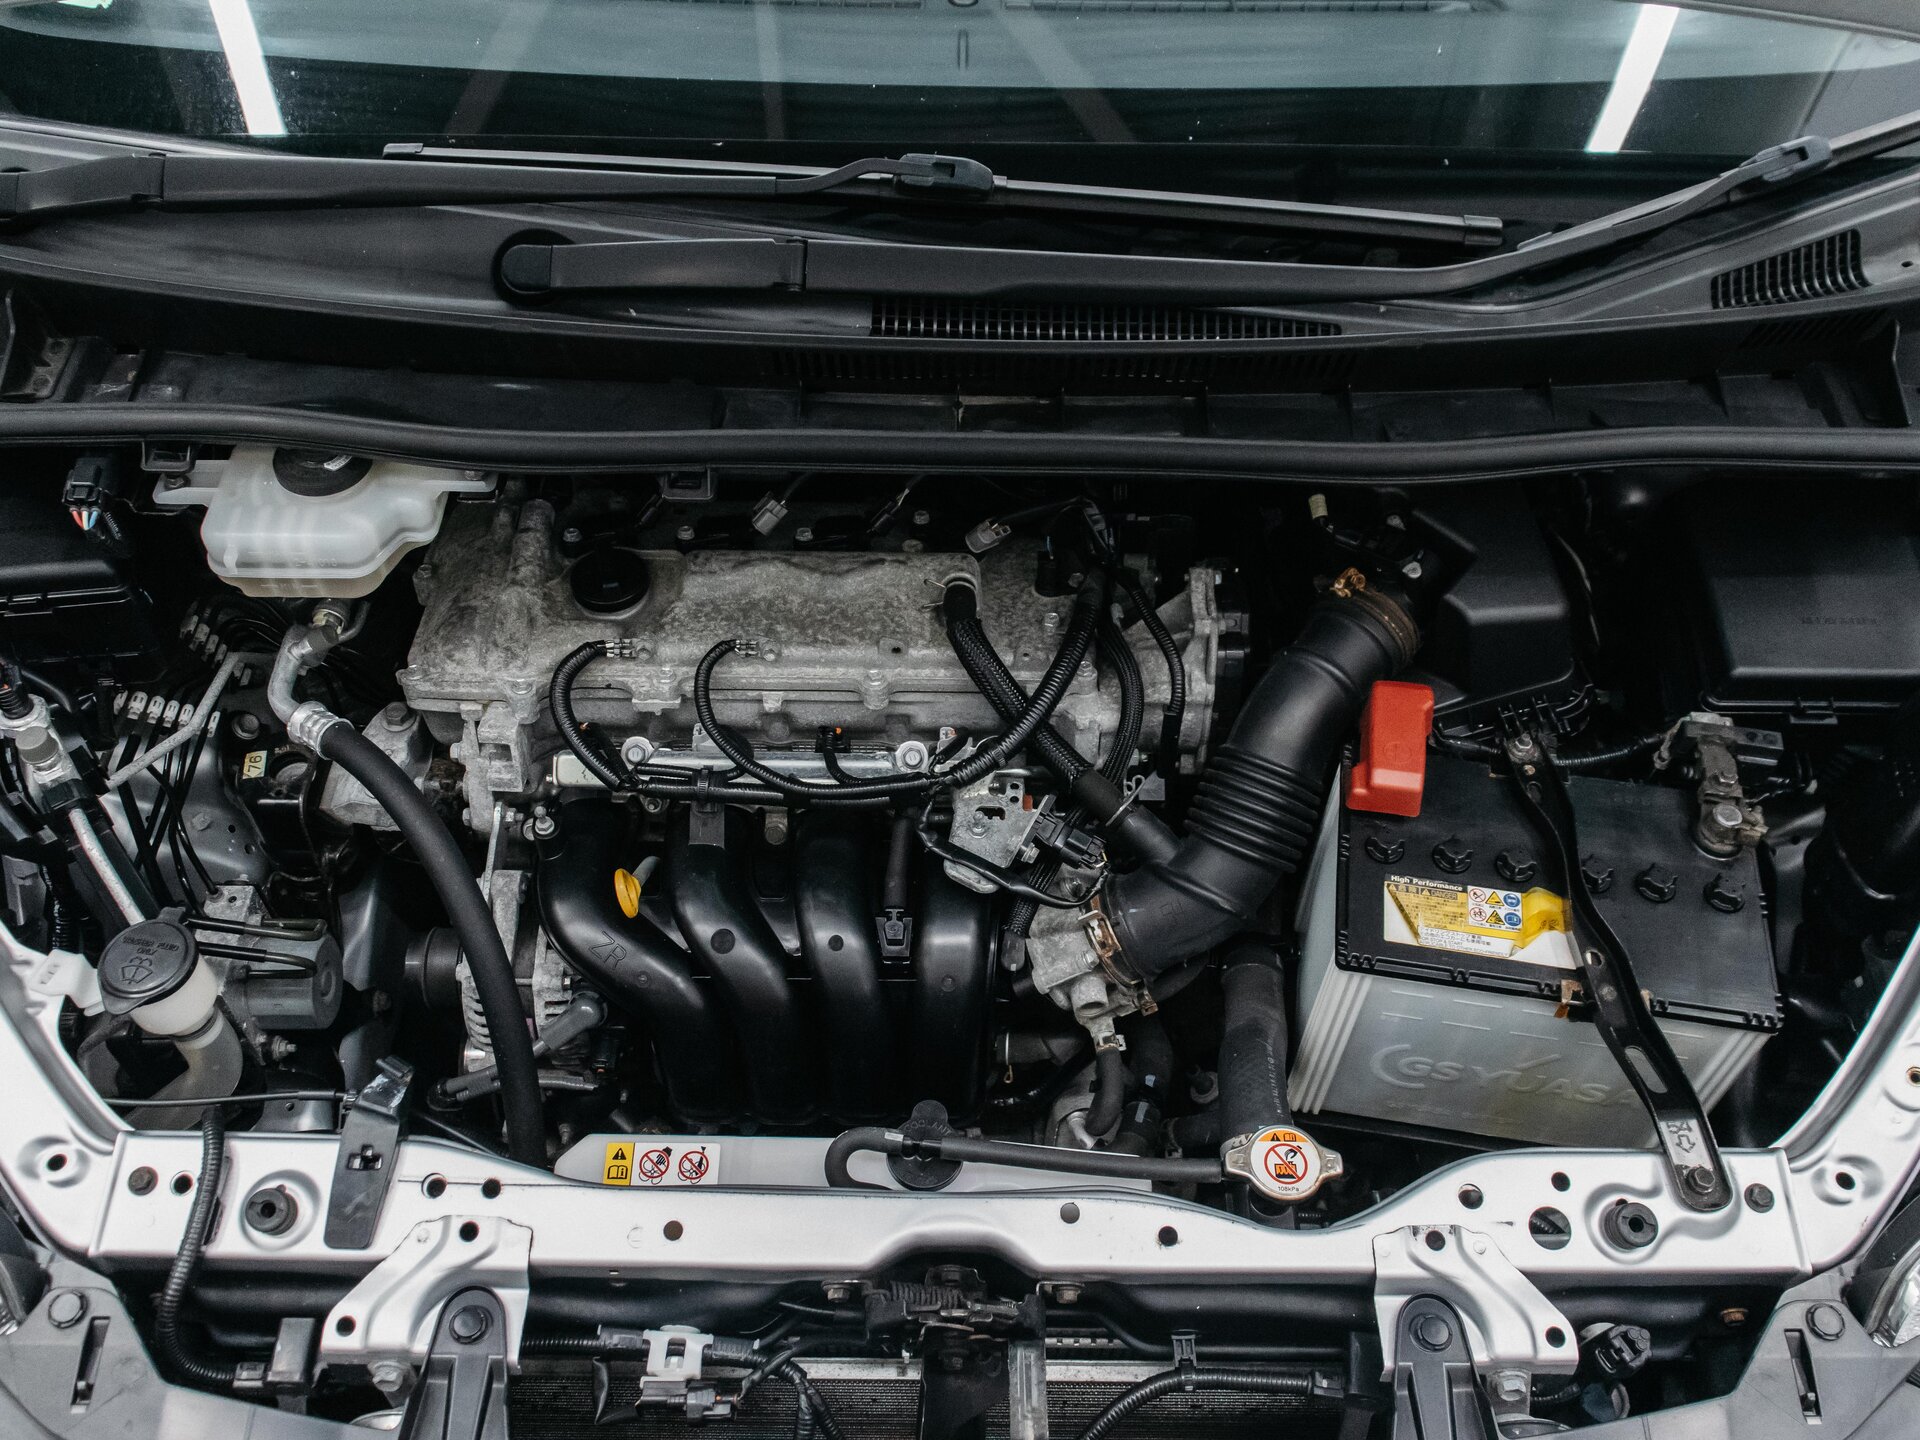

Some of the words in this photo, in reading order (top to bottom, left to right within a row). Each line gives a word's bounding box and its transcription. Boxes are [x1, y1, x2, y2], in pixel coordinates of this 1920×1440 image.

[1390, 875, 1410, 884] High
[1413, 878, 1463, 891] Performance
[1431, 889, 1458, 900] DANGER
[588, 930, 627, 970] ZR
[1399, 1056, 1464, 1082] GS
